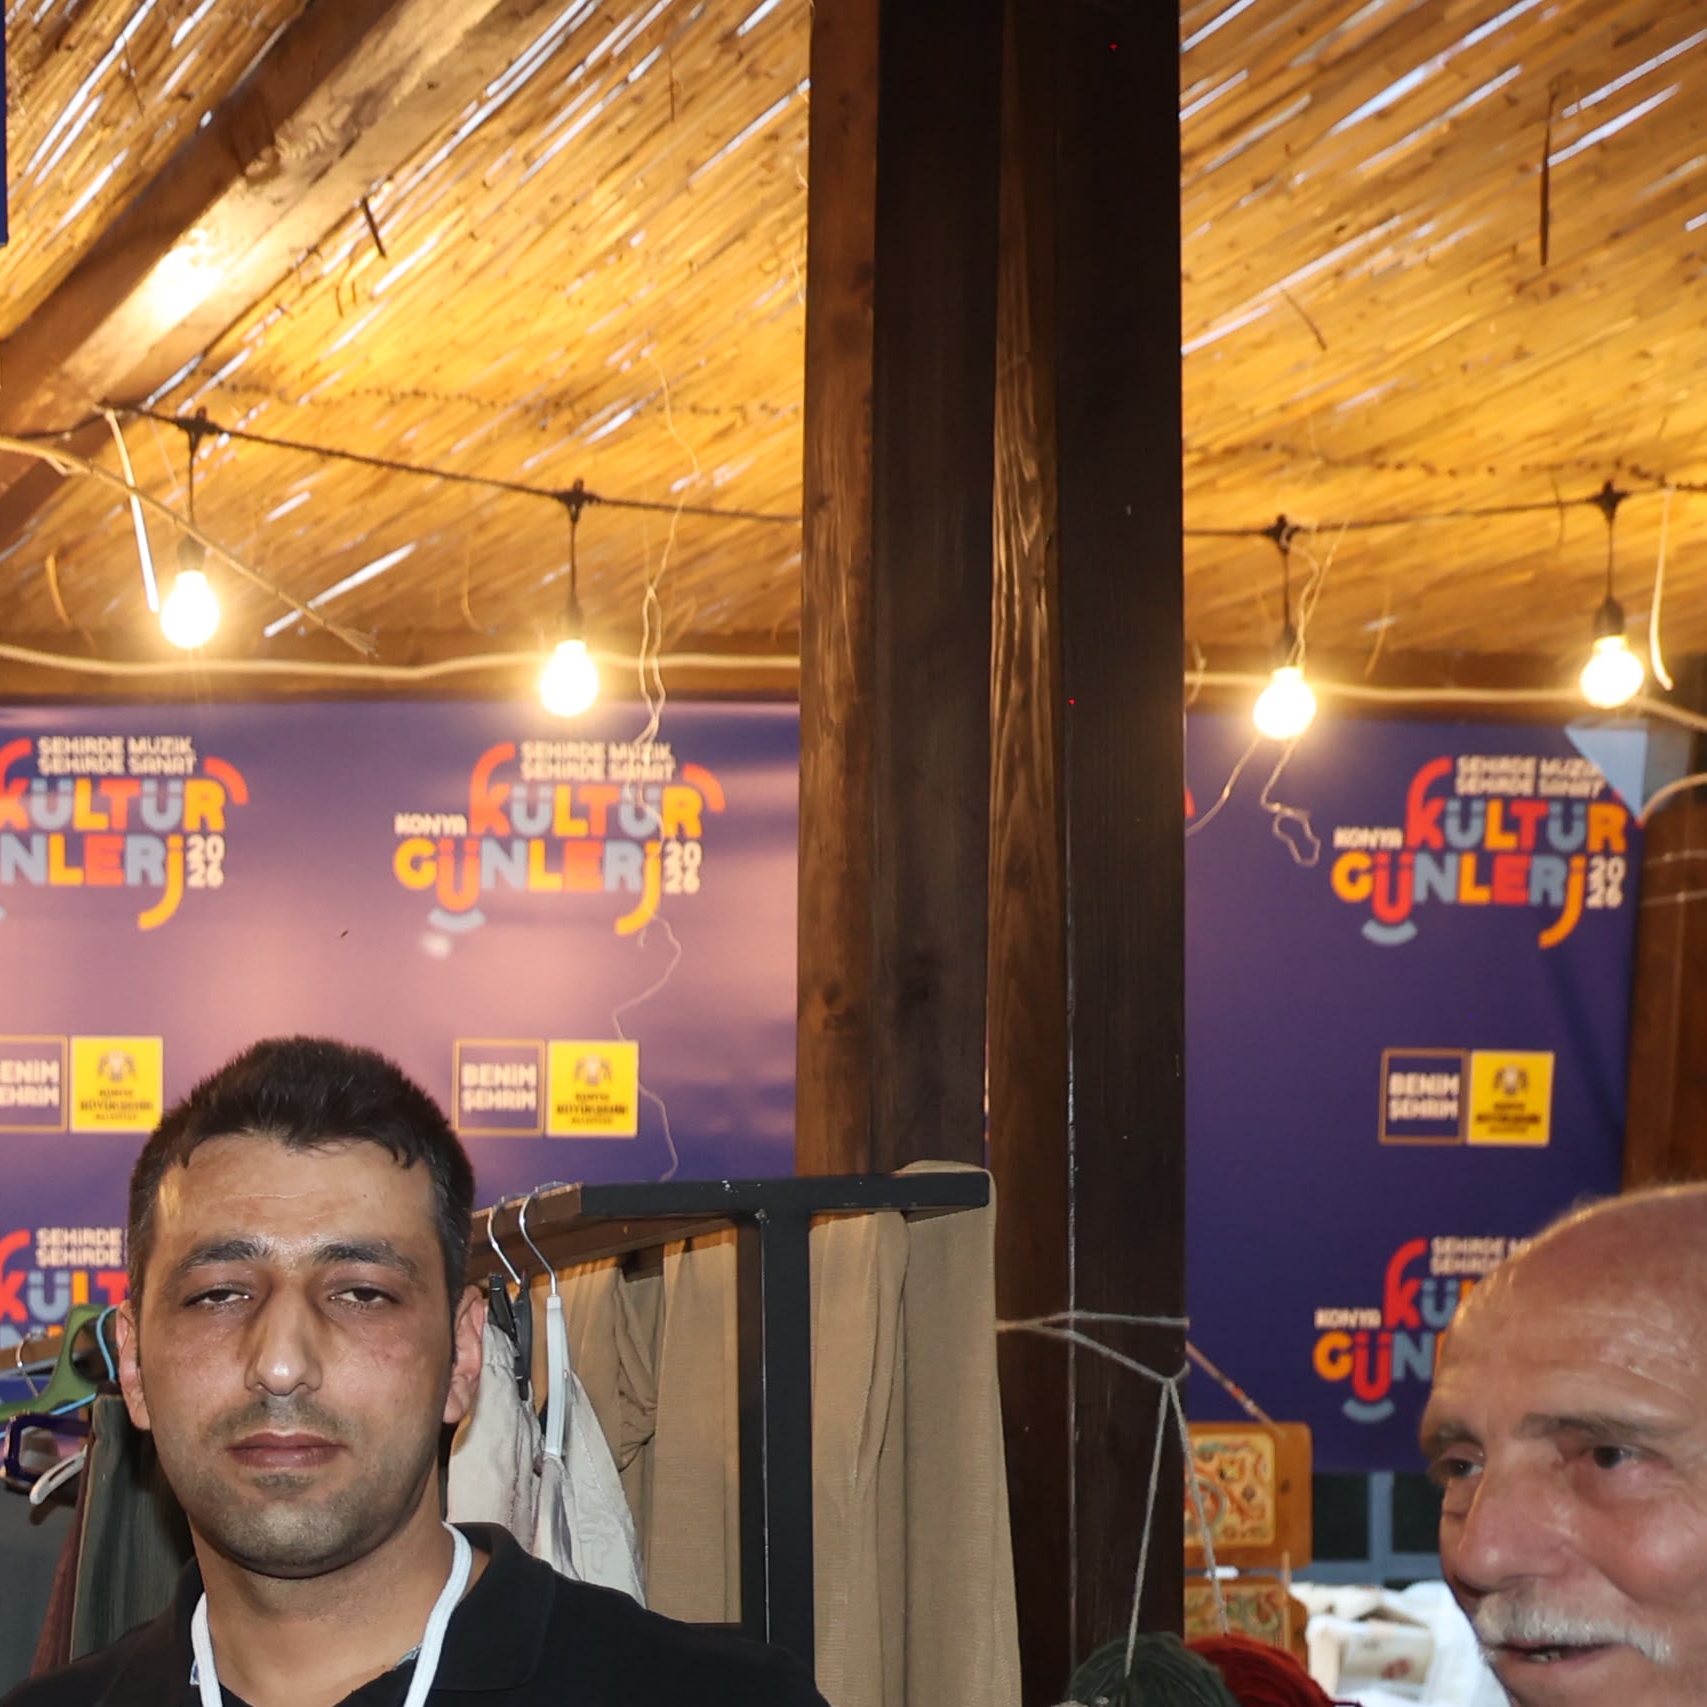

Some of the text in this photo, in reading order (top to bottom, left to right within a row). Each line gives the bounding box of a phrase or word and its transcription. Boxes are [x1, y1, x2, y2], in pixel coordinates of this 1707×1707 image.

[469, 742, 703, 837] KÜLTÜR
[1406, 756, 1627, 853] KÜLTÜR
[187, 834, 225, 860] 20
[664, 841, 702, 868] 20
[188, 860, 225, 888] 26
[665, 868, 700, 894] 26
[1588, 856, 1625, 881] 20
[1587, 882, 1623, 909] 26
